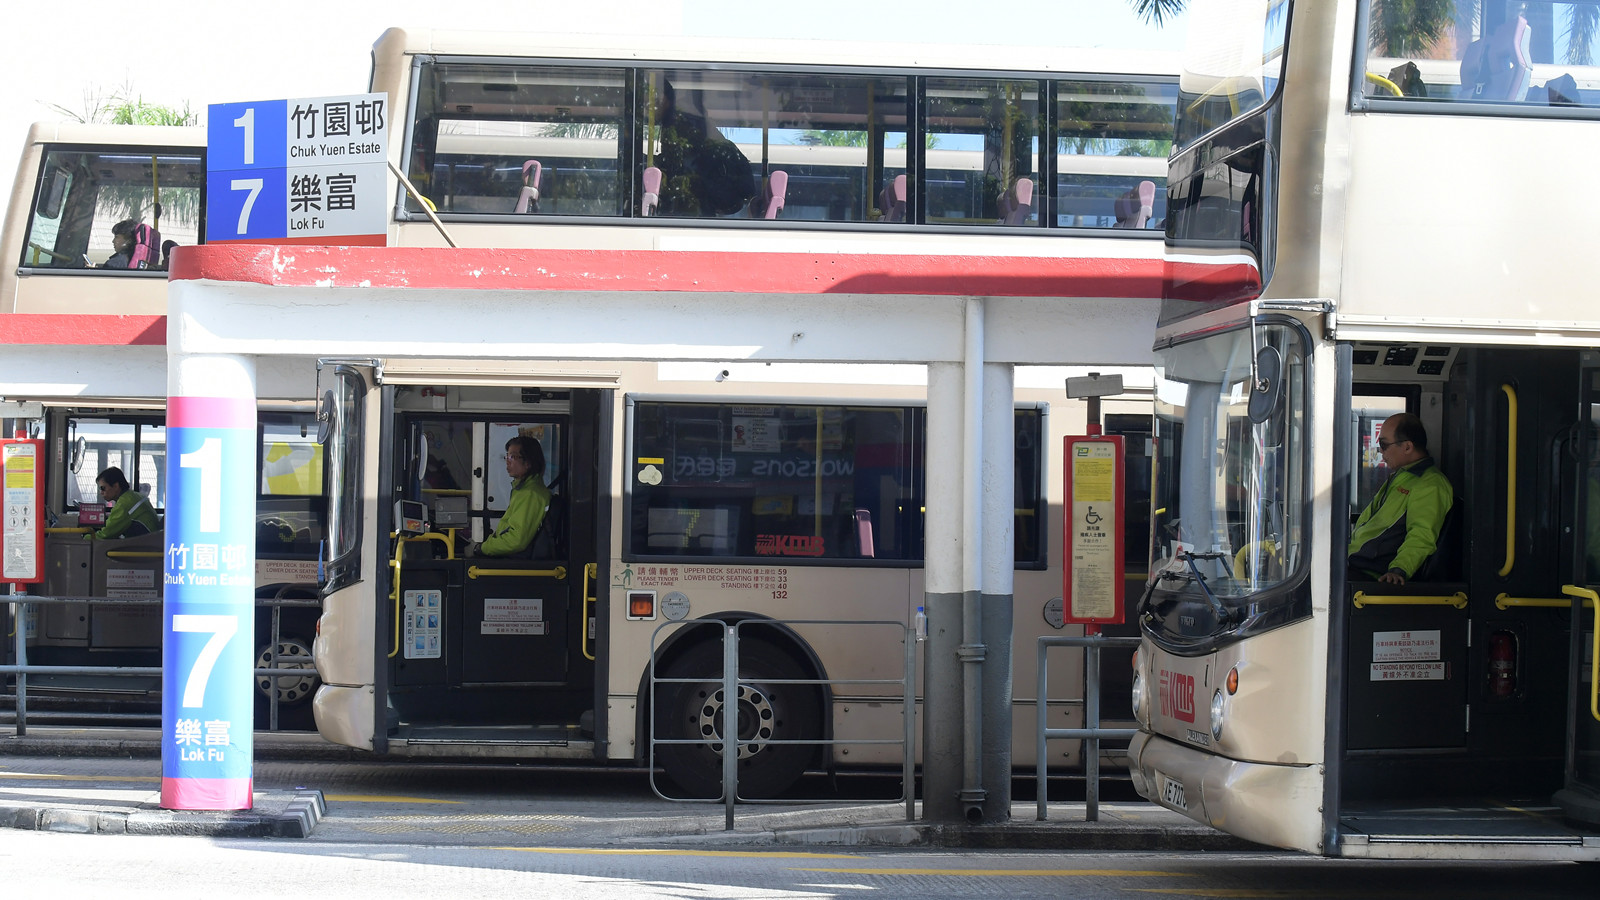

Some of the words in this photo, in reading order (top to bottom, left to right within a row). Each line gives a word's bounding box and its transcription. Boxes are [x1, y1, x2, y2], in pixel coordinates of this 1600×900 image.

[291, 100, 384, 139] 竹園邨
[234, 108, 255, 165] 1
[290, 145, 317, 158] Chuk
[319, 143, 345, 156] Yuen
[348, 142, 381, 155] Estate
[231, 178, 264, 235] 7
[290, 172, 357, 213] 樂富
[290, 218, 309, 230] Lok
[312, 217, 325, 229] Fu
[180, 437, 222, 533] 1
[677, 508, 701, 548] 7
[168, 543, 247, 571] 竹園邨
[775, 535, 825, 556] KMB
[164, 572, 185, 585] Chuk
[187, 572, 217, 586] Yuen
[771, 590, 788, 599] 132
[172, 614, 238, 708] 7
[1169, 670, 1196, 724] KMB
[174, 718, 231, 746] 樂富
[181, 747, 205, 762] Lok
[207, 748, 225, 762] Fu
